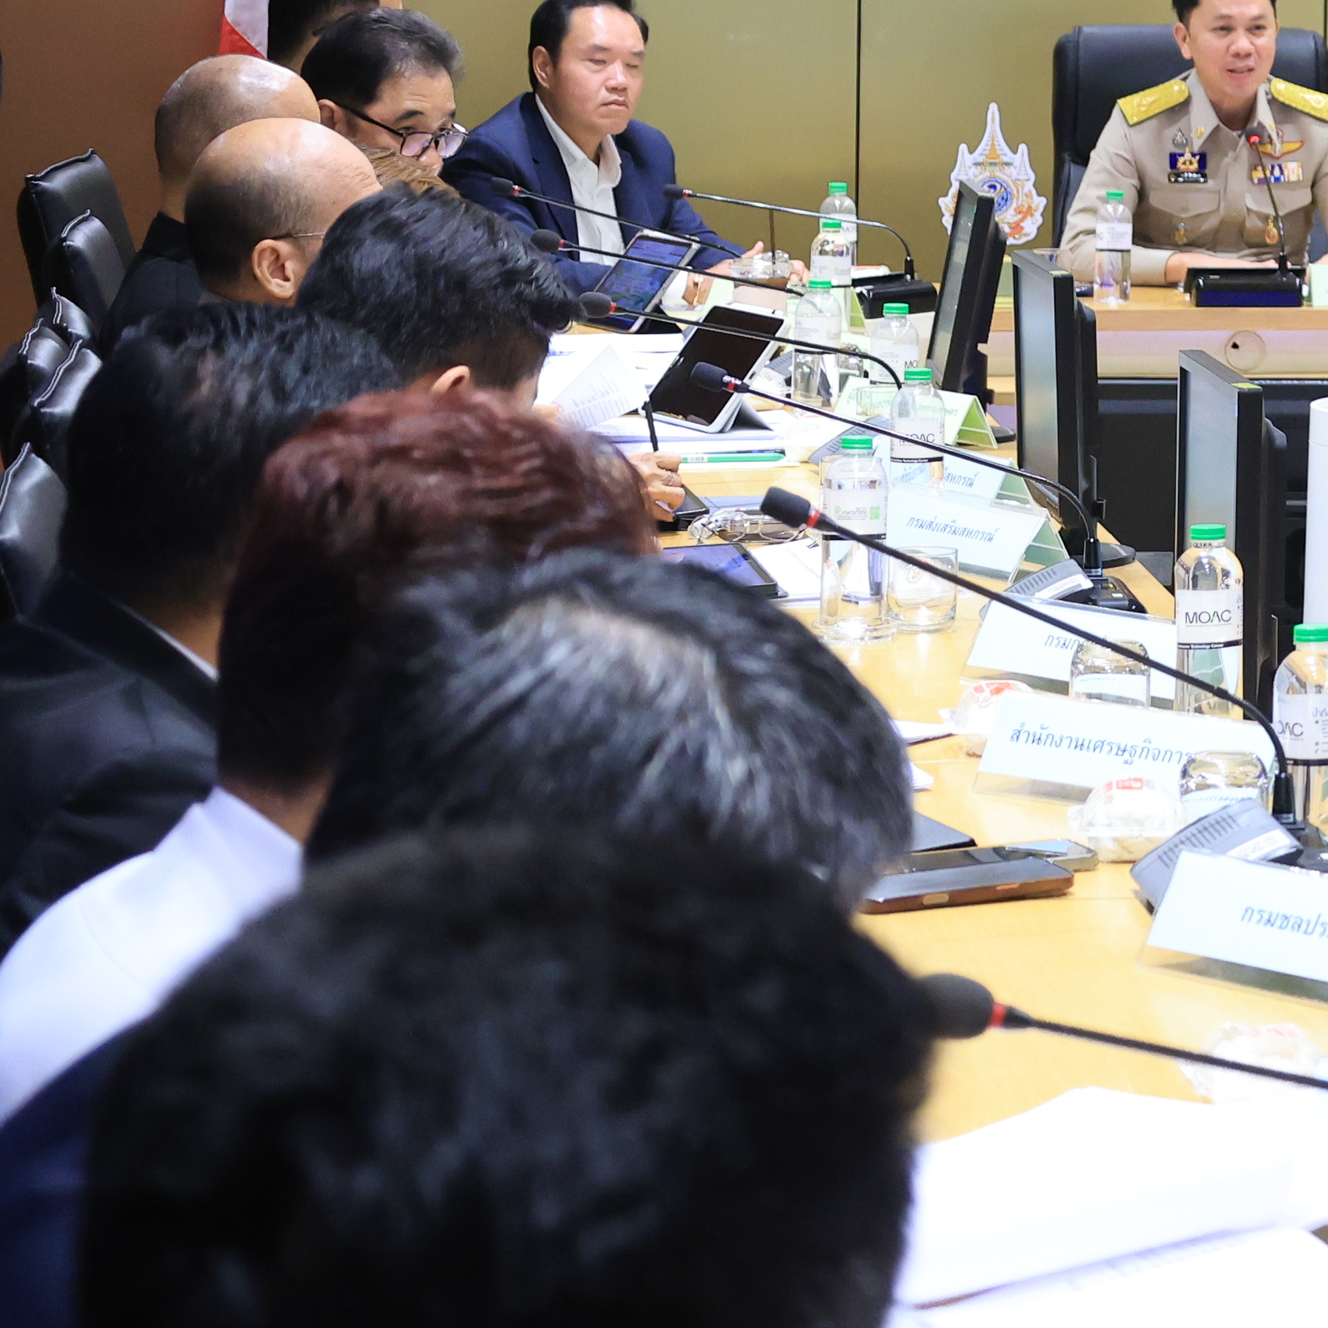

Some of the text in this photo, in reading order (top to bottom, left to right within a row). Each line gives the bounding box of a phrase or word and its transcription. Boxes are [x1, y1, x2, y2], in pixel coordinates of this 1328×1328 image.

[906, 516, 1001, 543] กรมส่งเสริมสหกรณ์
[1184, 609, 1232, 624] MOAC
